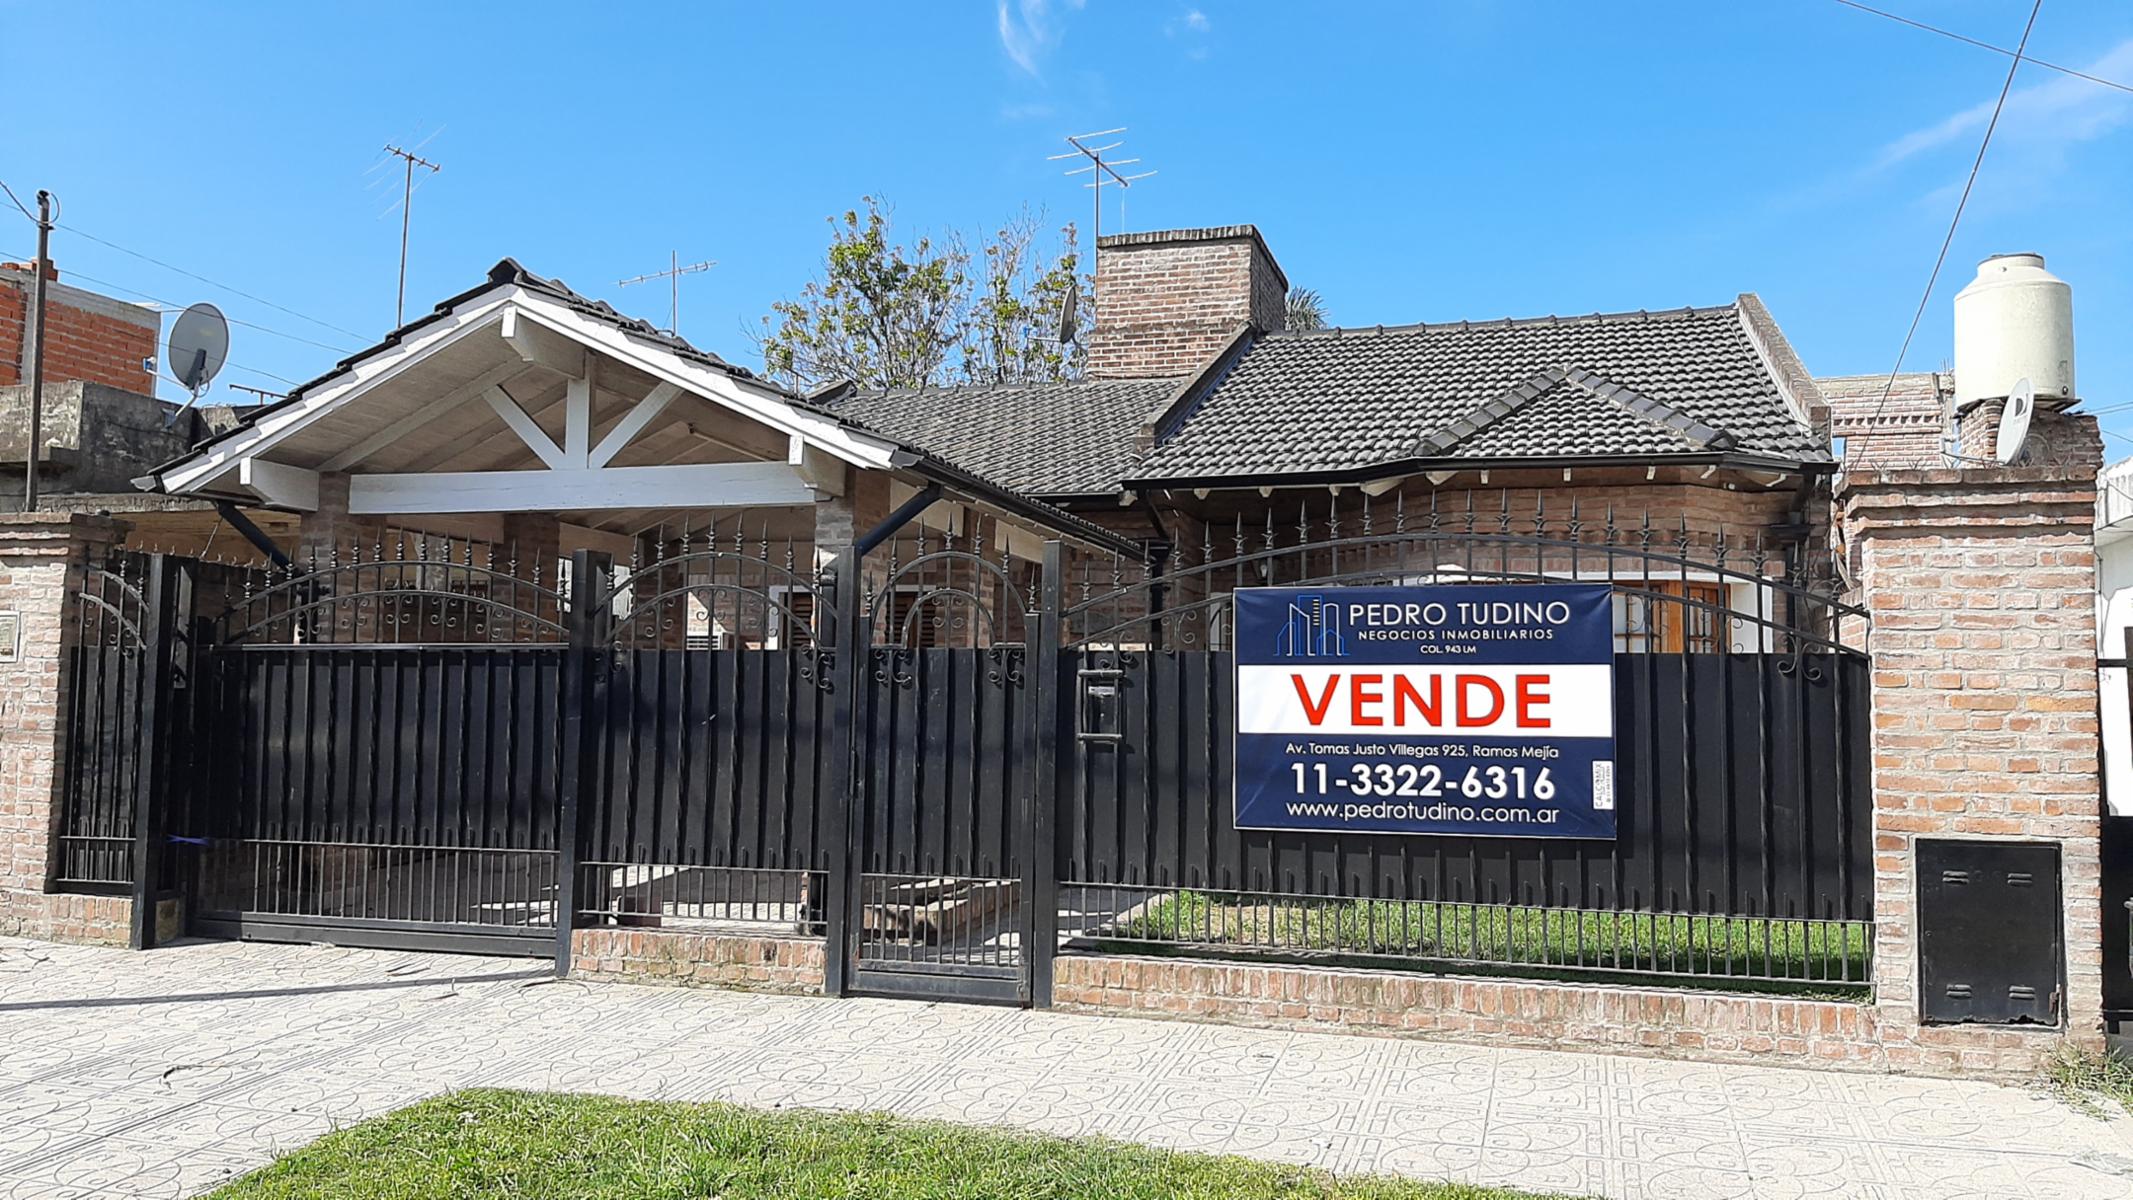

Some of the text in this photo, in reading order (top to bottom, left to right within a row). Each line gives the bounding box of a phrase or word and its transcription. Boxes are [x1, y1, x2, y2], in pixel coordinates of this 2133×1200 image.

[1349, 601, 1570, 626] PEDRO TUDINO
[1358, 629, 1553, 641] NEGOCIOS INMOBILIARIOS
[1445, 645, 1462, 654] 943
[1463, 645, 1477, 654] LM
[1291, 674, 1551, 728] VENDE
[1286, 743, 1559, 761] Av. Tomas Justo Villegas 925, Ramos Mejía
[1291, 762, 1556, 800] 11-3322-6316
[1286, 802, 1560, 824] www.pedrotudino.com.ar
